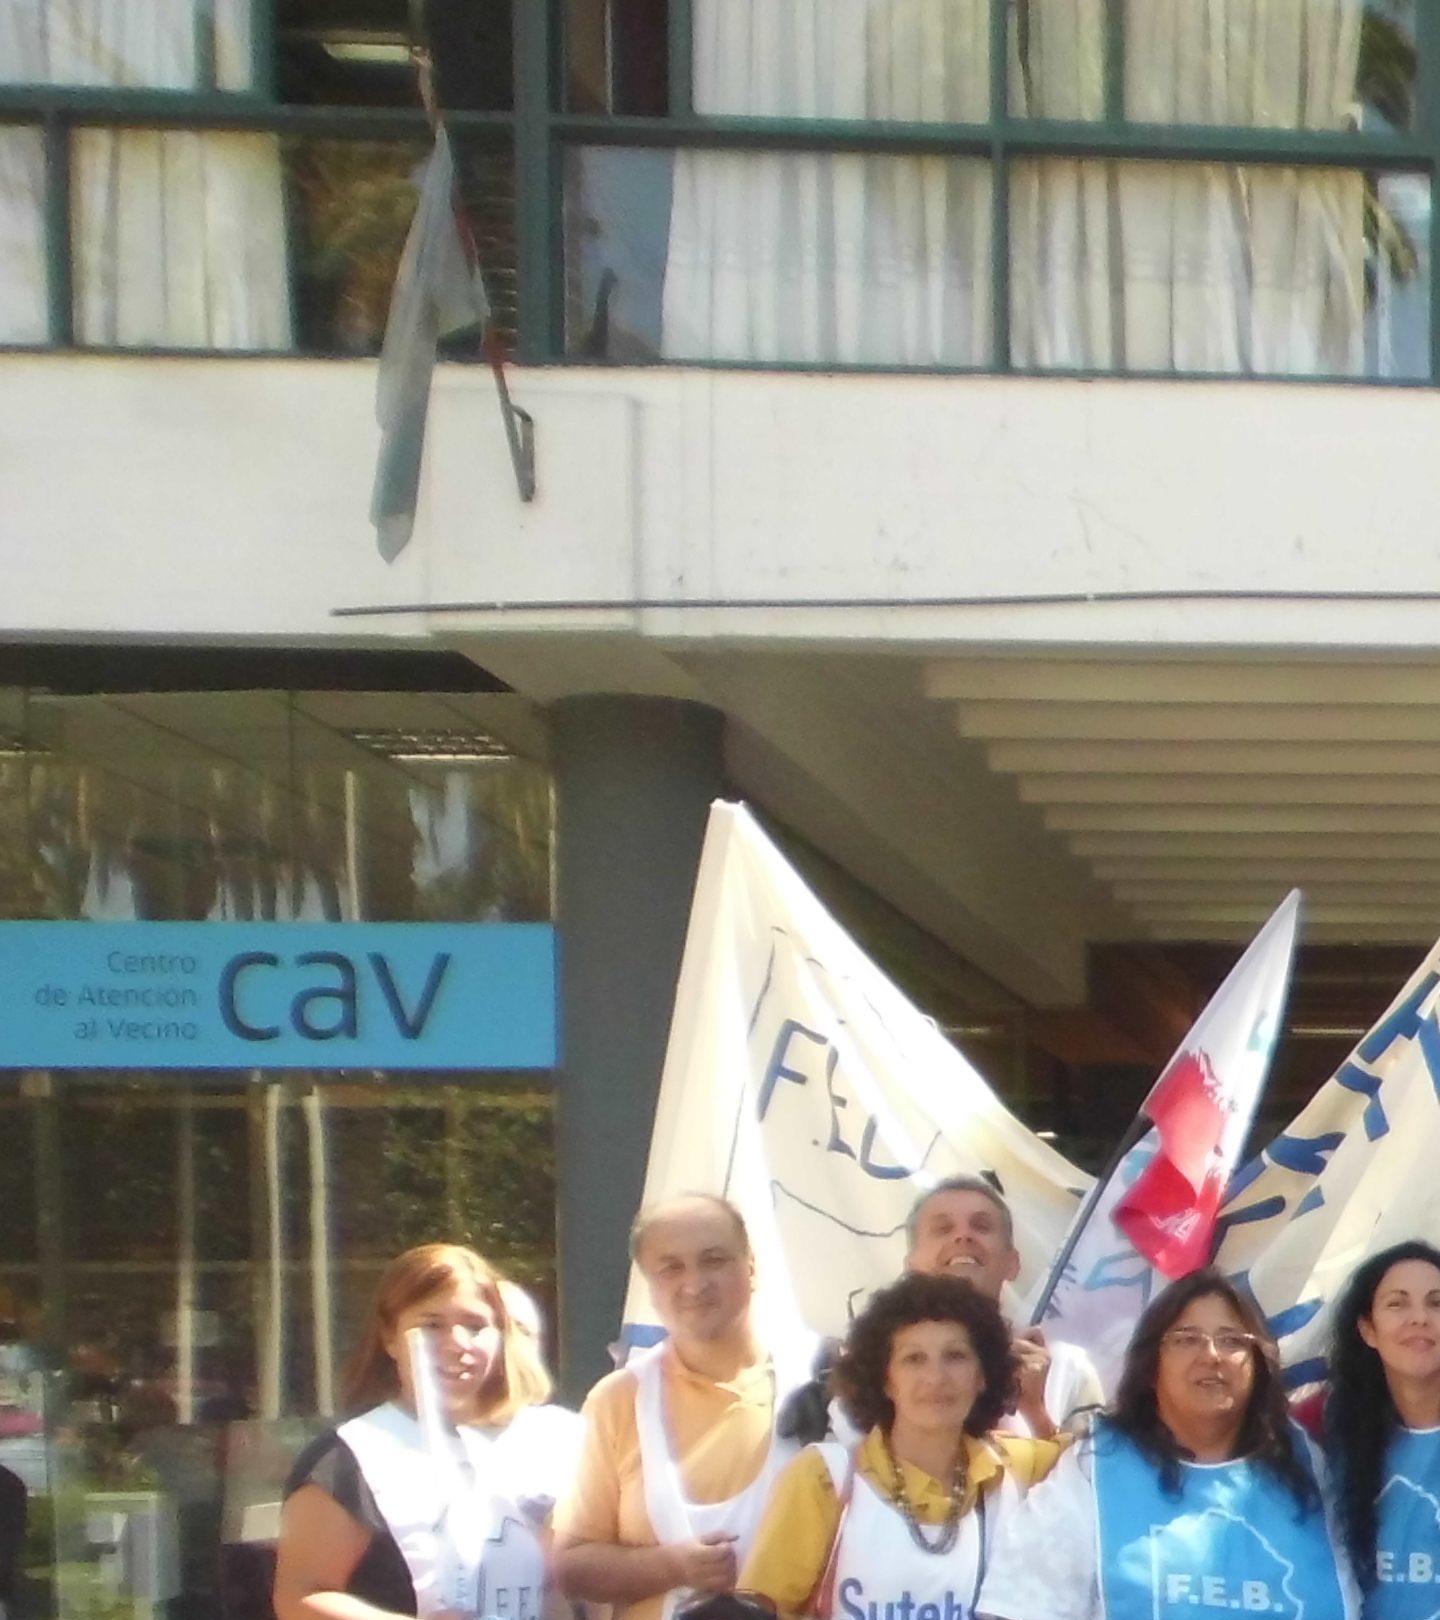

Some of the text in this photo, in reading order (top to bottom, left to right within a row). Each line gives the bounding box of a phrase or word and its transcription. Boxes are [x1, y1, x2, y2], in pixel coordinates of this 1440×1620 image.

[107, 950, 197, 974] Centro
[34, 983, 197, 1007] de Atención
[218, 950, 452, 1042] cav
[74, 1017, 197, 1041] al Vecino
[1166, 1573, 1284, 1613] F.E.B.
